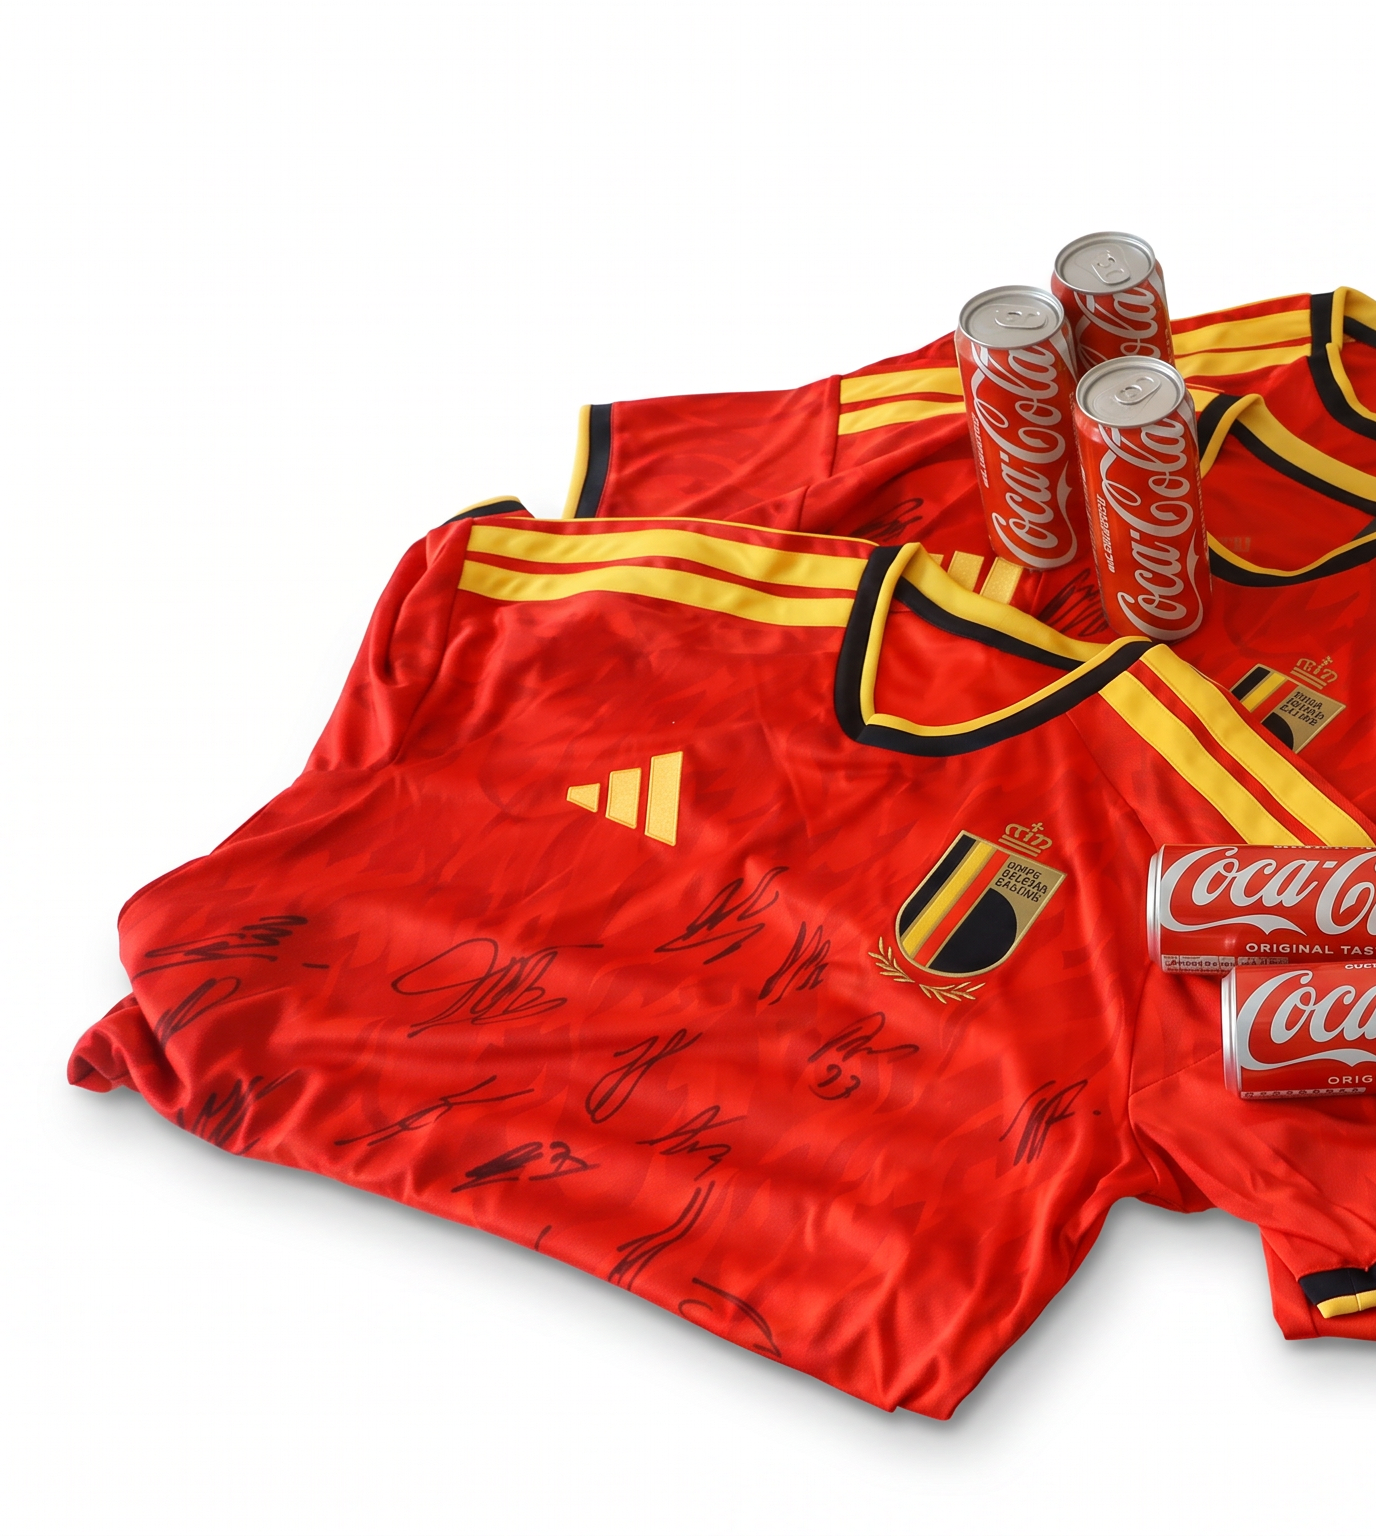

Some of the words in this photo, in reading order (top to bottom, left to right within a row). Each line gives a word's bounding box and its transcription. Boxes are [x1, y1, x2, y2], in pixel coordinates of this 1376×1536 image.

[970, 340, 1078, 569] Coca-Cola
[1100, 407, 1204, 641] Coca-Cola
[1245, 942, 1334, 956] ORIGINAL
